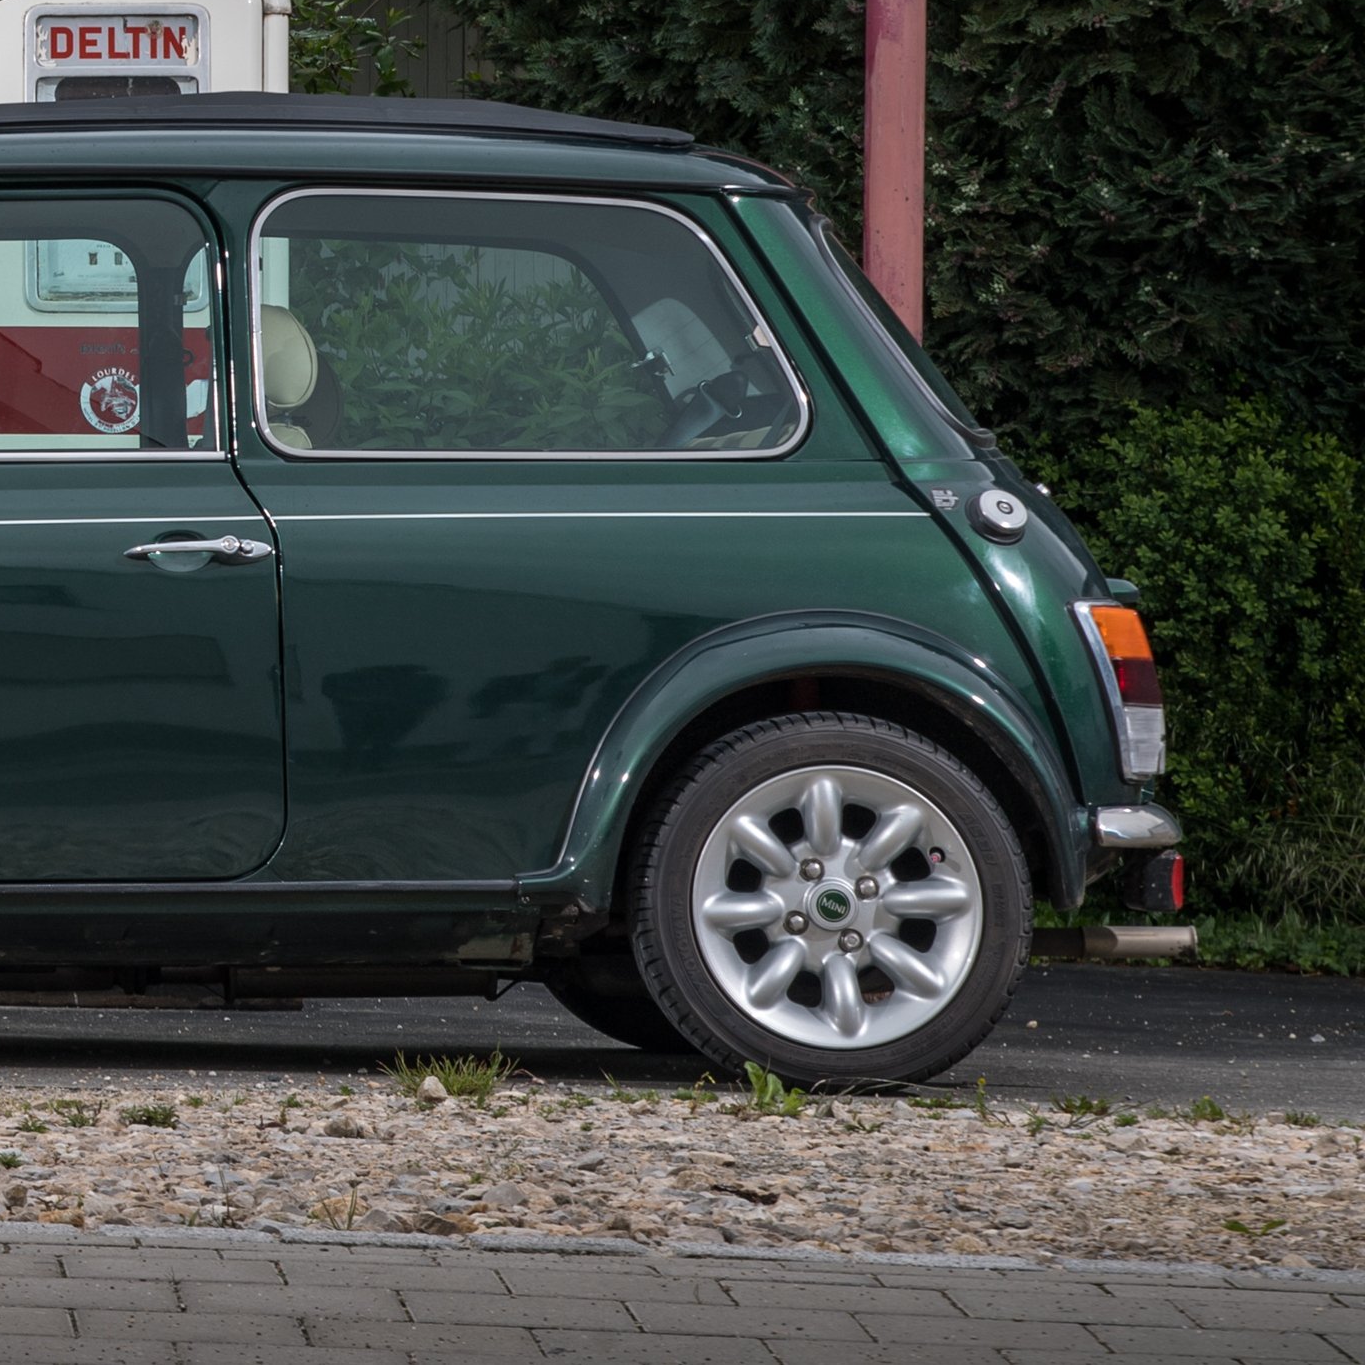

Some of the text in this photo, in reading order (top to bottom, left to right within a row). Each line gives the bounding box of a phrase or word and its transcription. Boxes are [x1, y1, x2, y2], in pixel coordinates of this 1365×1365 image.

[49, 26, 187, 60] DELTIN
[91, 367, 136, 383] LOURDES
[820, 896, 847, 915] MINI
